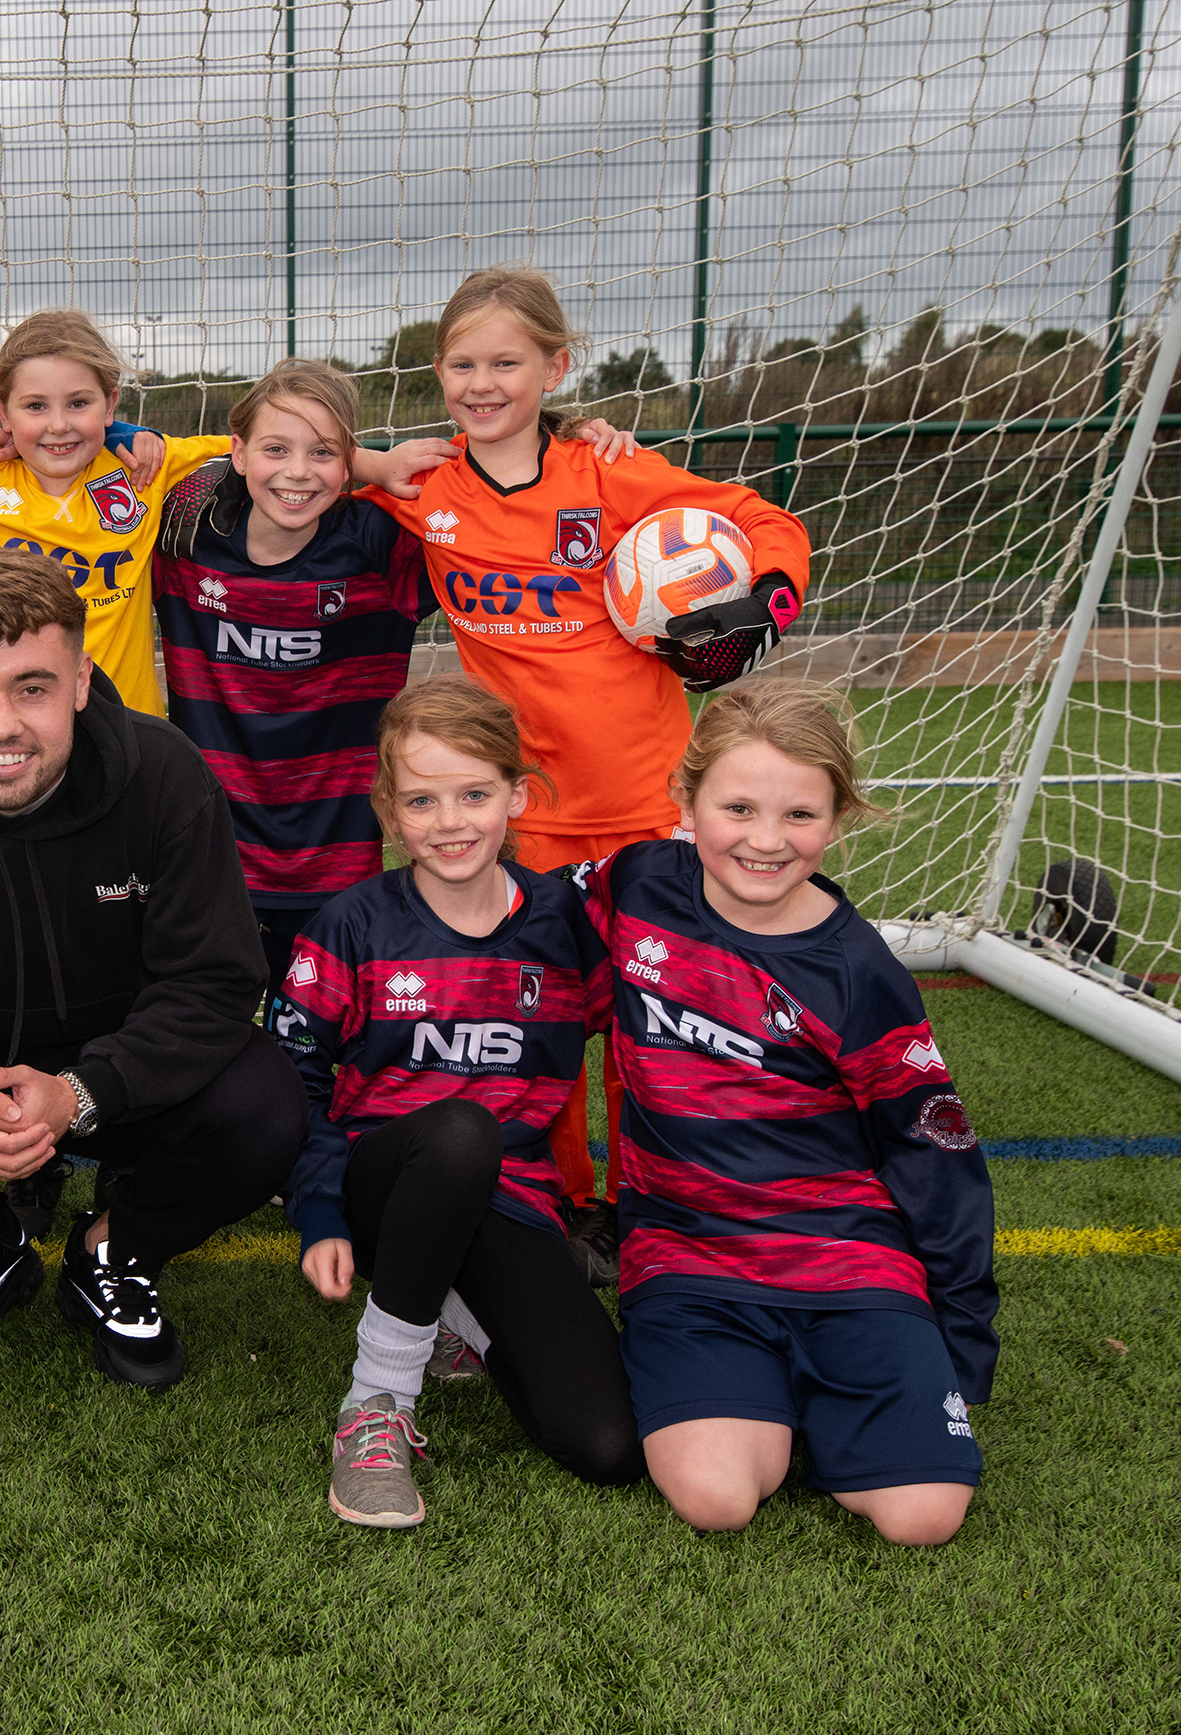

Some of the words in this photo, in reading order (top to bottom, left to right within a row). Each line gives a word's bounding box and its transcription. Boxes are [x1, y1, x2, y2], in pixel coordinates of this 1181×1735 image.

[425, 531, 456, 544] errea
[92, 593, 121, 608] TUBES
[445, 571, 582, 617] CST
[197, 594, 227, 612] errea
[489, 623, 516, 634] STEEL
[518, 623, 527, 634] &
[530, 621, 563, 634] TUBES
[565, 620, 584, 632] LTD
[216, 619, 322, 661] NTS
[626, 959, 662, 984] errea
[386, 998, 426, 1012] errea
[411, 1022, 524, 1064] NTS
[448, 1062, 470, 1073] Tube
